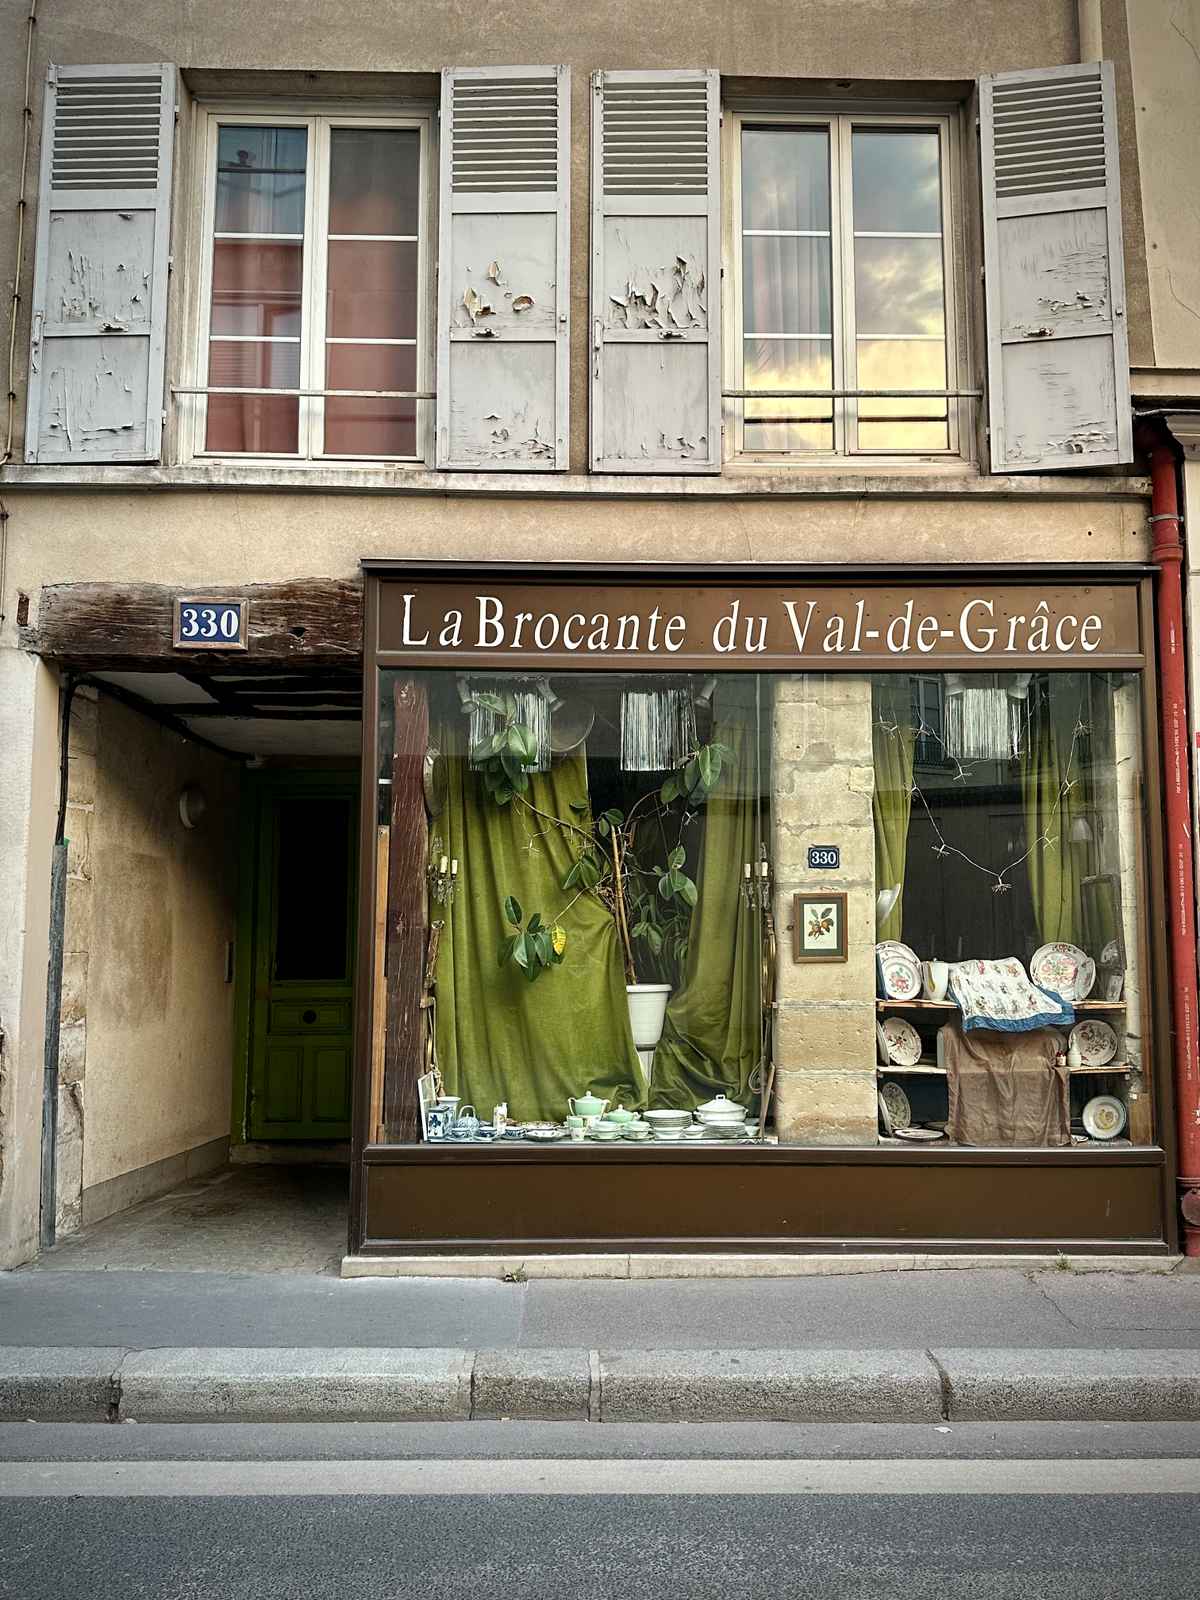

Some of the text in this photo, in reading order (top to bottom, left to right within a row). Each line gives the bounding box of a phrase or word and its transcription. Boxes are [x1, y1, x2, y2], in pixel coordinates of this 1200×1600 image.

[182, 608, 239, 638] 330
[401, 594, 1102, 654] La Brocante du Val-de-Grâce
[811, 851, 837, 865] 330
